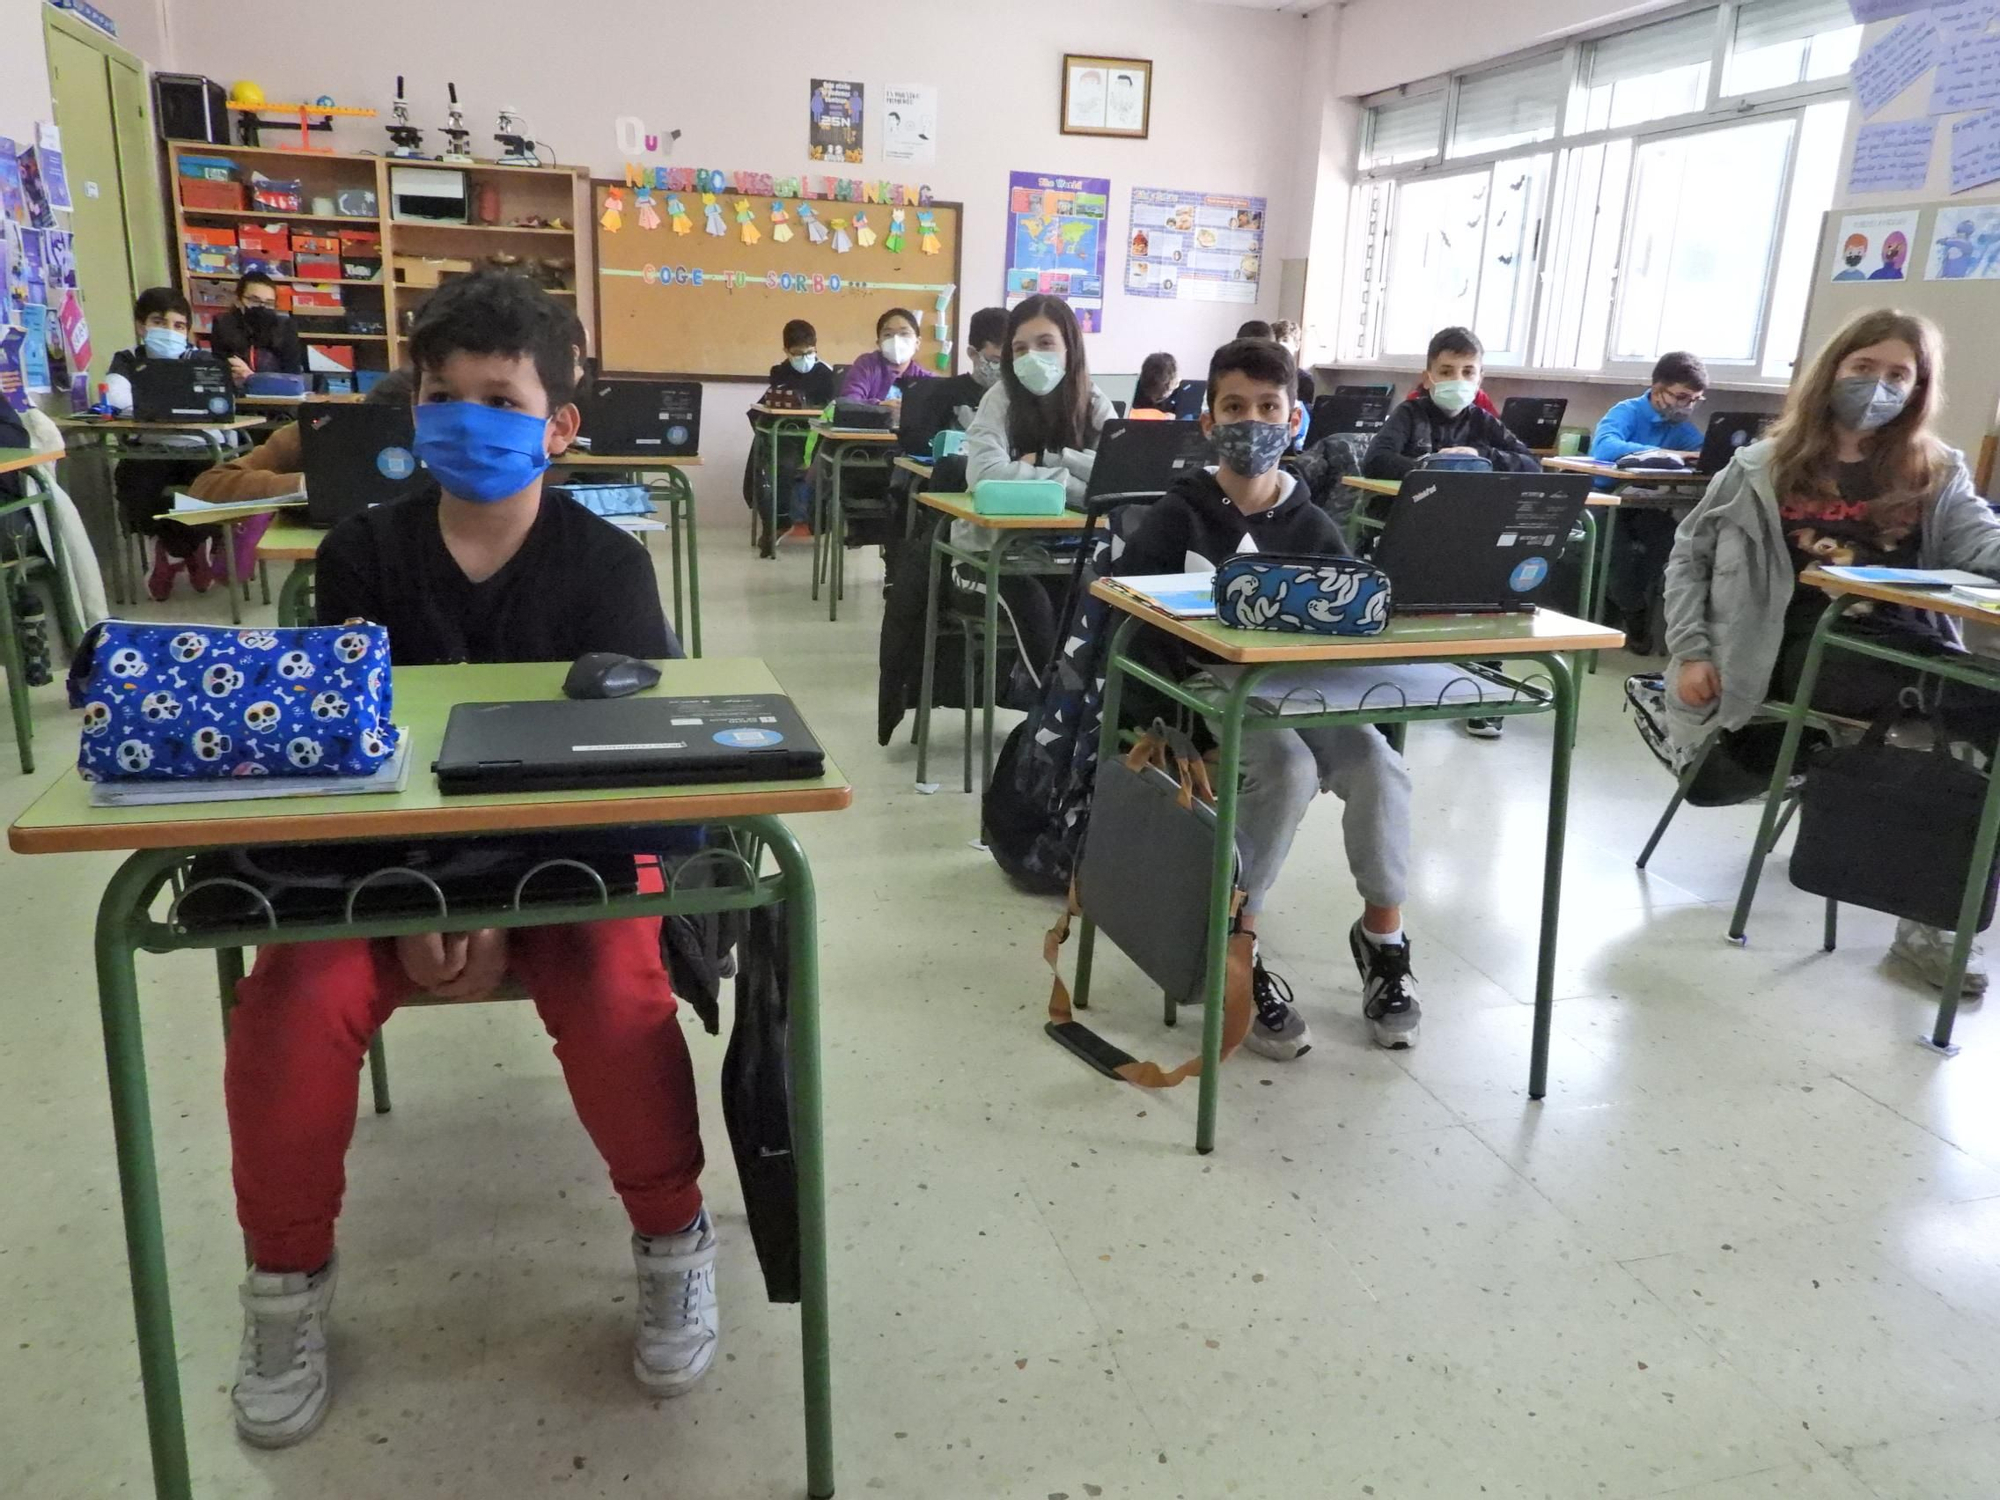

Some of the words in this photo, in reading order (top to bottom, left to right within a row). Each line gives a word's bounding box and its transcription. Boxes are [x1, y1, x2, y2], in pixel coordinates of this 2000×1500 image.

[821, 115, 851, 127] 25N
[625, 162, 726, 194] NUESTRO
[734, 169, 817, 199] VISUAL
[823, 176, 934, 207] THINKING
[642, 263, 704, 286] COGE
[724, 270, 746, 288] TU
